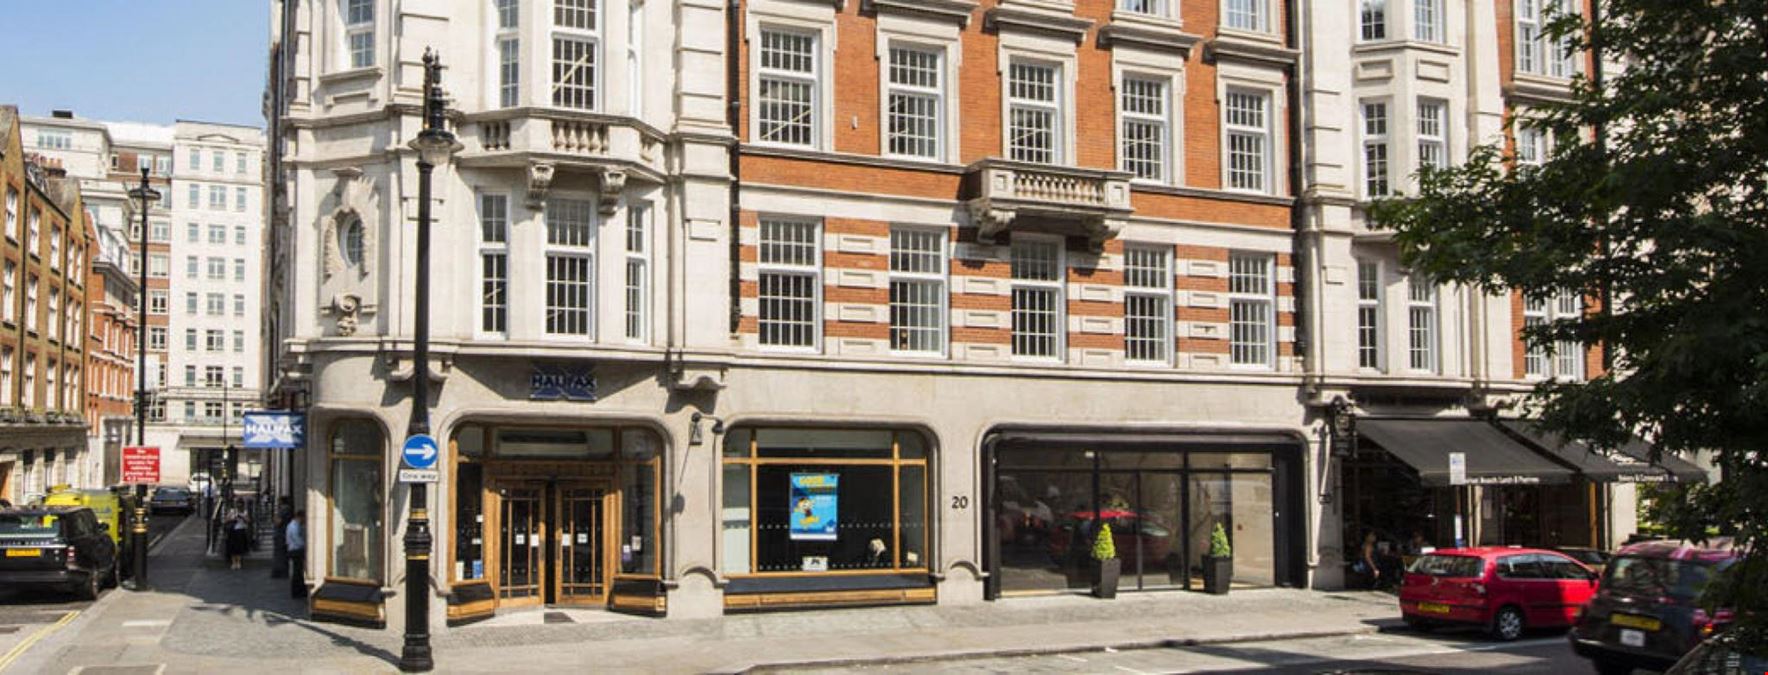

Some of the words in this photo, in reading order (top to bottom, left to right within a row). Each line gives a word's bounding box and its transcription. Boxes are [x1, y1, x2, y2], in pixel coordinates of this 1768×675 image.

[529, 374, 598, 390] HALIFAX
[245, 424, 303, 435] HALIFAX
[951, 495, 968, 509] 20
